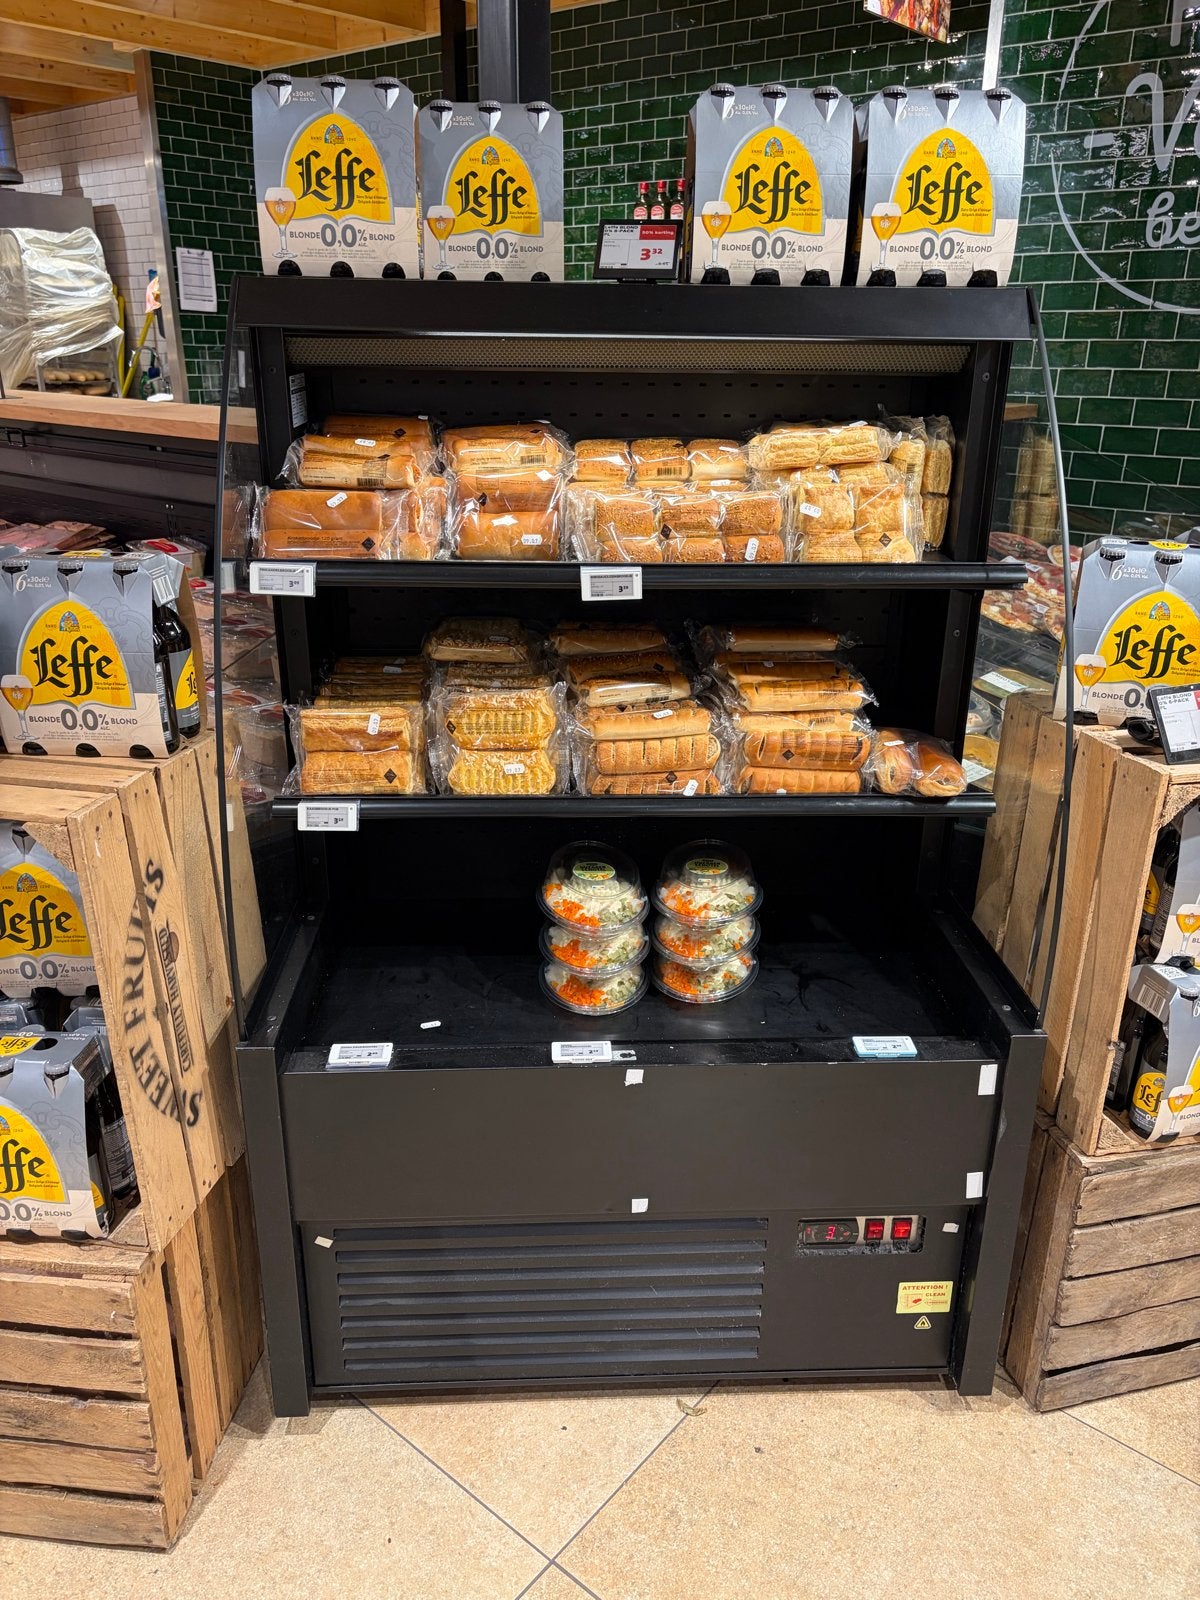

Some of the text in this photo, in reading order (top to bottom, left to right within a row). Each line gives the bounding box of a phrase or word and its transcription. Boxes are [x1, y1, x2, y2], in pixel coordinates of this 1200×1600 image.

[295, 147, 376, 212] Leffe
[455, 168, 528, 227] Leffe
[734, 160, 812, 225] Leffe
[904, 161, 983, 226] Leffe
[290, 224, 395, 248] BLONDE 0,0% BLOND
[751, 236, 796, 260] 0,0%
[797, 245, 823, 253] BLOND
[476, 237, 519, 260] 0,0%
[640, 248, 651, 261] 3
[889, 245, 919, 253] BLONDE
[919, 237, 965, 261] 0,0%
[1109, 624, 1197, 679] Leffe
[29, 636, 113, 698] Leffe
[1092, 692, 1124, 700] BLONDE
[29, 715, 61, 723] BLONDE
[61, 708, 109, 731] 0,0%
[19, 960, 70, 980] 0,0%
[173, 1003, 192, 1074] CAREFULLY
